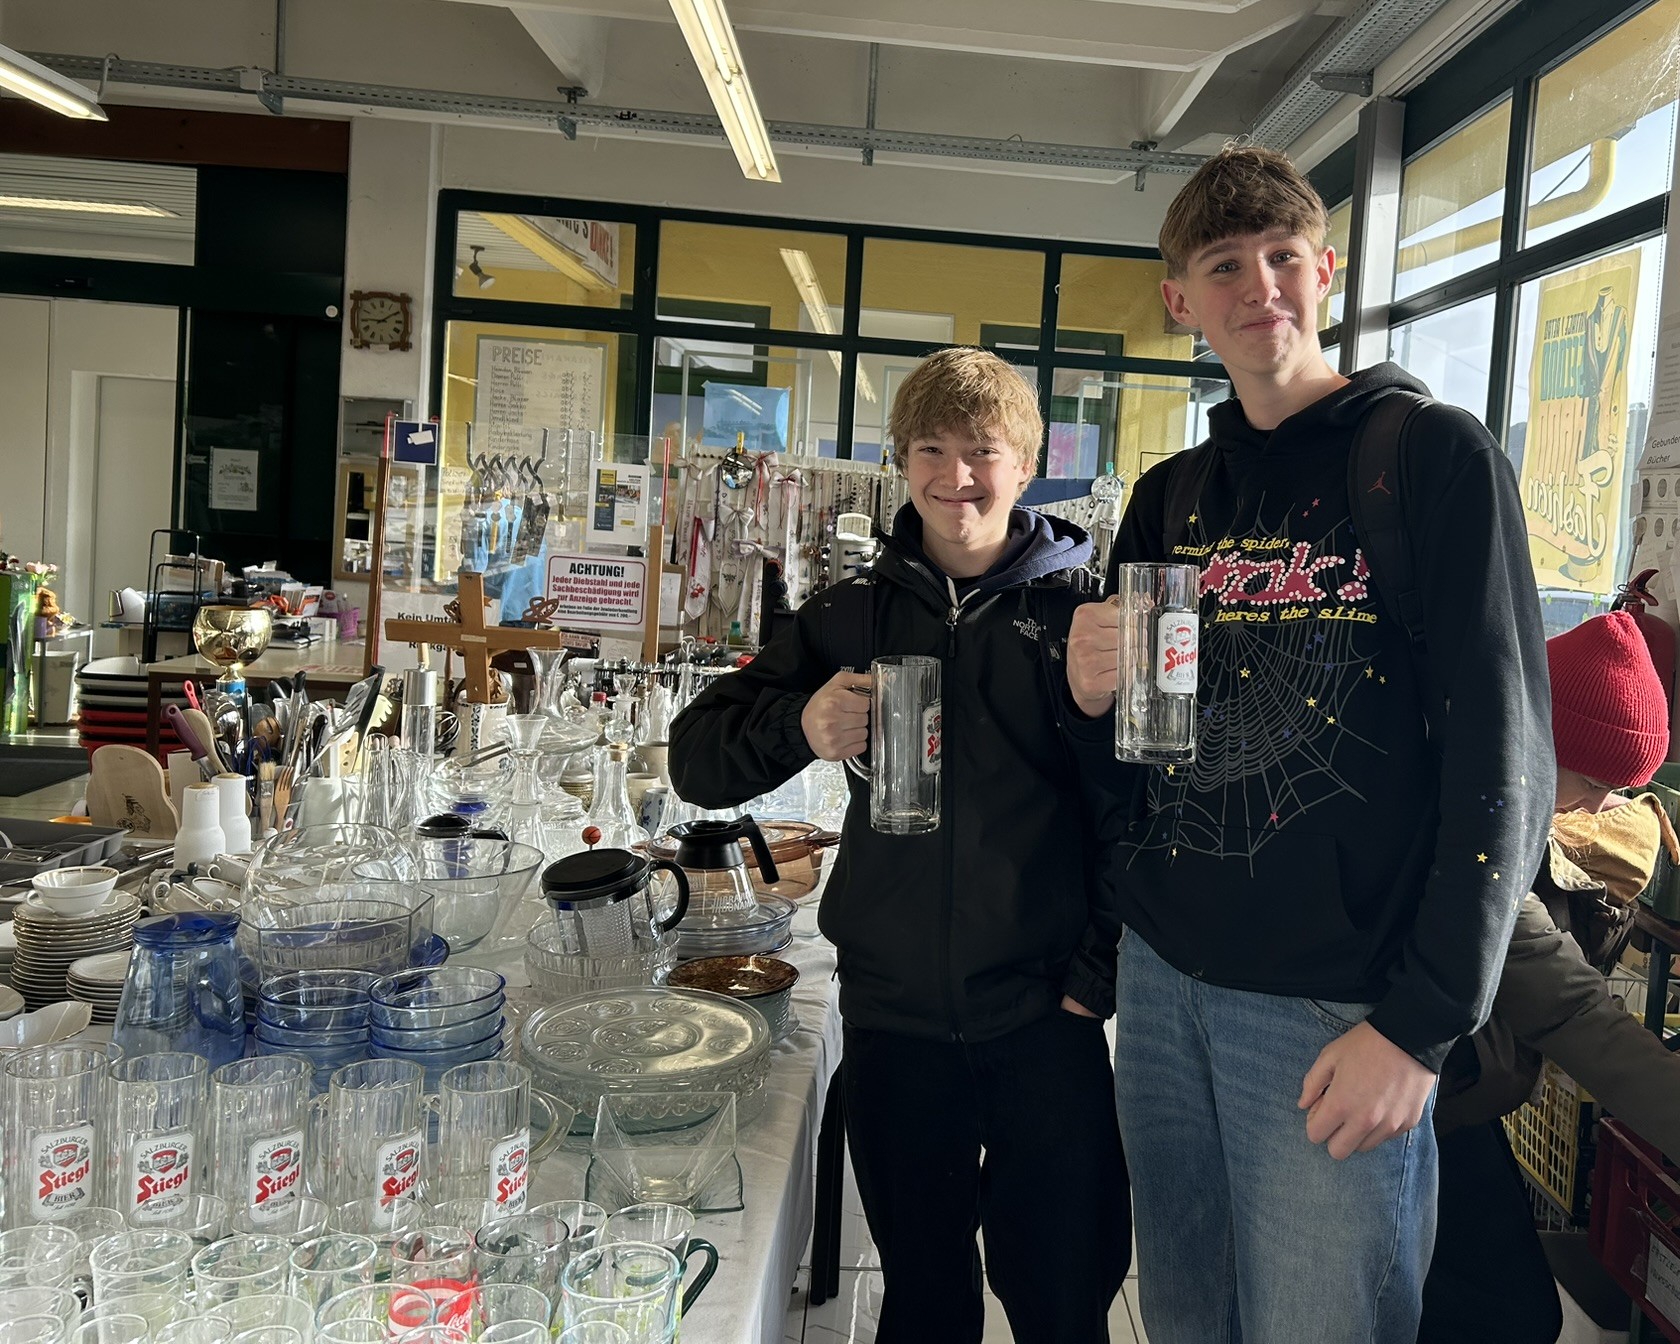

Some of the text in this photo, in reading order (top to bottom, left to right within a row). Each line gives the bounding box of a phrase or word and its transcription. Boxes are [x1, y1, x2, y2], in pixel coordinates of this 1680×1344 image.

[492, 345, 542, 366] PREISE
[1646, 453, 1671, 466] Bücher
[1217, 536, 1235, 550] the
[569, 562, 625, 578] ACHTUNG!
[552, 575, 640, 589] Jeder Diebstahl und jede
[552, 584, 639, 598] Sachbeschädigung wird
[569, 594, 597, 604] Anzeige
[598, 596, 633, 606] gebracht.
[397, 612, 422, 622] Kein
[1214, 605, 1378, 624] heres the slime
[1020, 628, 1039, 641] FACE
[40, 1135, 89, 1155] SALZBURGER
[140, 1141, 188, 1160] SALZBURGER
[38, 1159, 90, 1200] Stiegl
[136, 1165, 189, 1204] Stiegl
[255, 1163, 300, 1204] Stiegl
[379, 1164, 419, 1208] Stiegl
[54, 1191, 76, 1202] BIER
